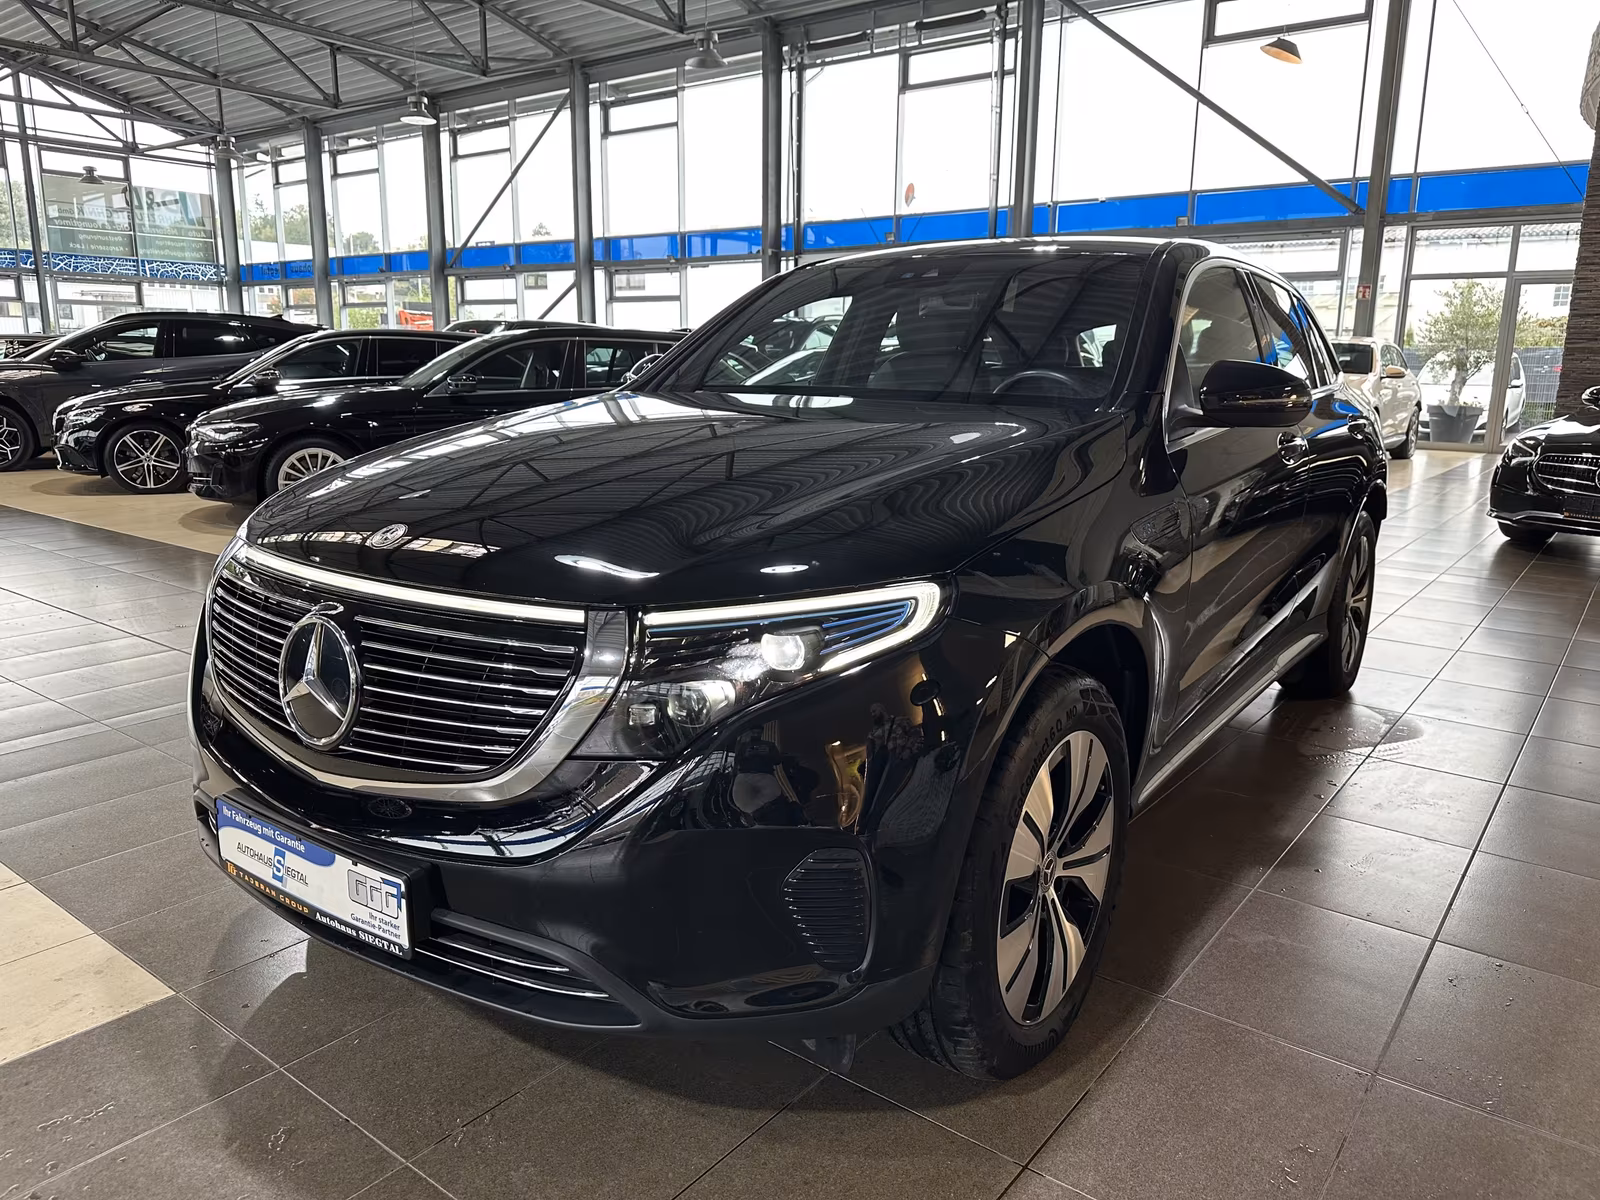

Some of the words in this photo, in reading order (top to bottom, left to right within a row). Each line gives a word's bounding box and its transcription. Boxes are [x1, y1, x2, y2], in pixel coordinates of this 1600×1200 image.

[222, 805, 232, 818] Ihr
[231, 809, 262, 834] Fahrzeug
[262, 826, 275, 839] mit
[274, 830, 306, 853] Garantie
[236, 842, 273, 867] AUTOHAUS
[279, 894, 310, 914] GROUP
[315, 911, 357, 937] Autohaus
[358, 930, 403, 956] SIEGTAL
[350, 912, 401, 940] Garantie-Partner
[368, 911, 378, 922] Ihr
[378, 916, 401, 931] starker
